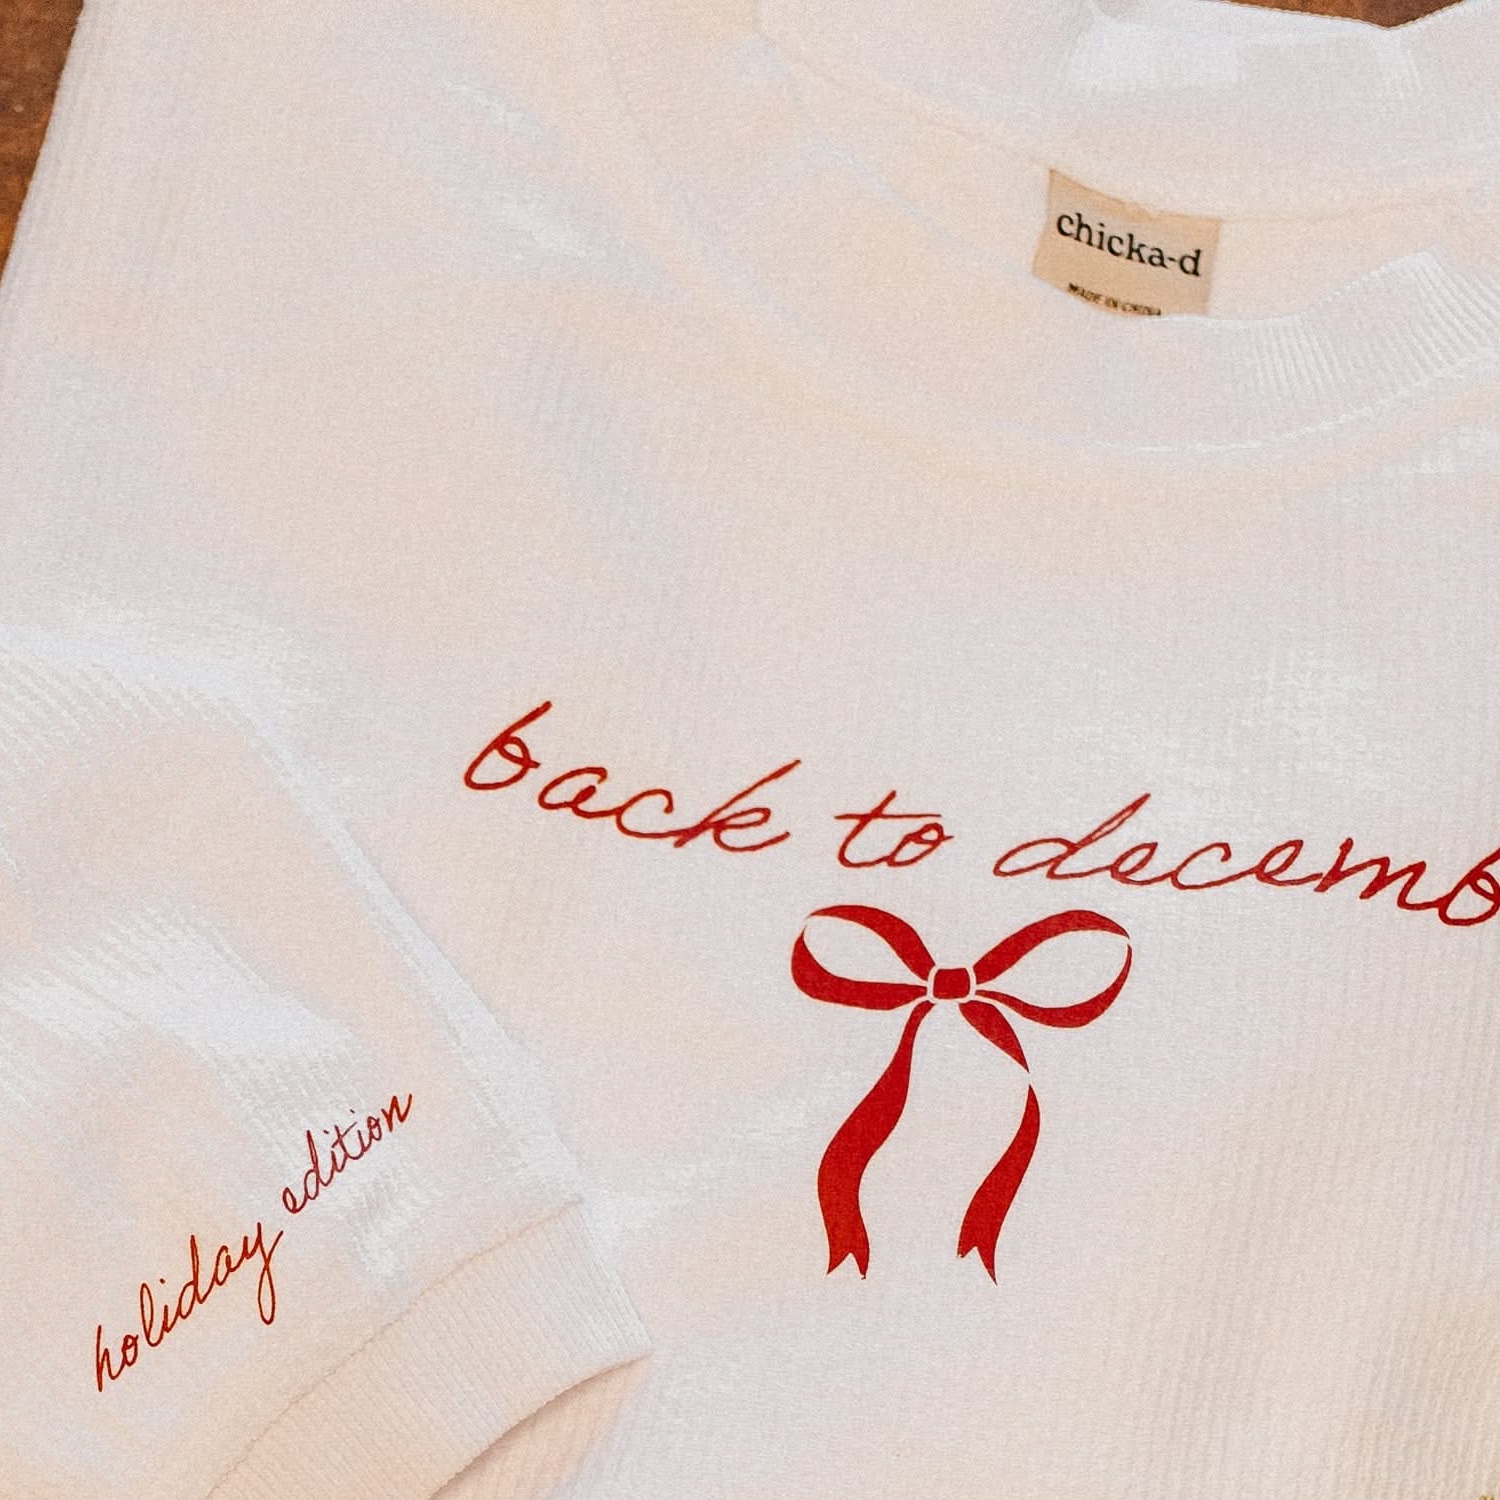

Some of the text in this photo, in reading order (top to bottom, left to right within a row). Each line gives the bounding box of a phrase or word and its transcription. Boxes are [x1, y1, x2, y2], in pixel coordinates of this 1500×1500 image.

[1057, 212, 1202, 277] chicka-d
[1068, 283, 1102, 304] MADE
[1105, 297, 1118, 310] IN
[463, 700, 802, 854] back
[834, 789, 954, 869] to
[95, 1093, 413, 1392] holiday edition
